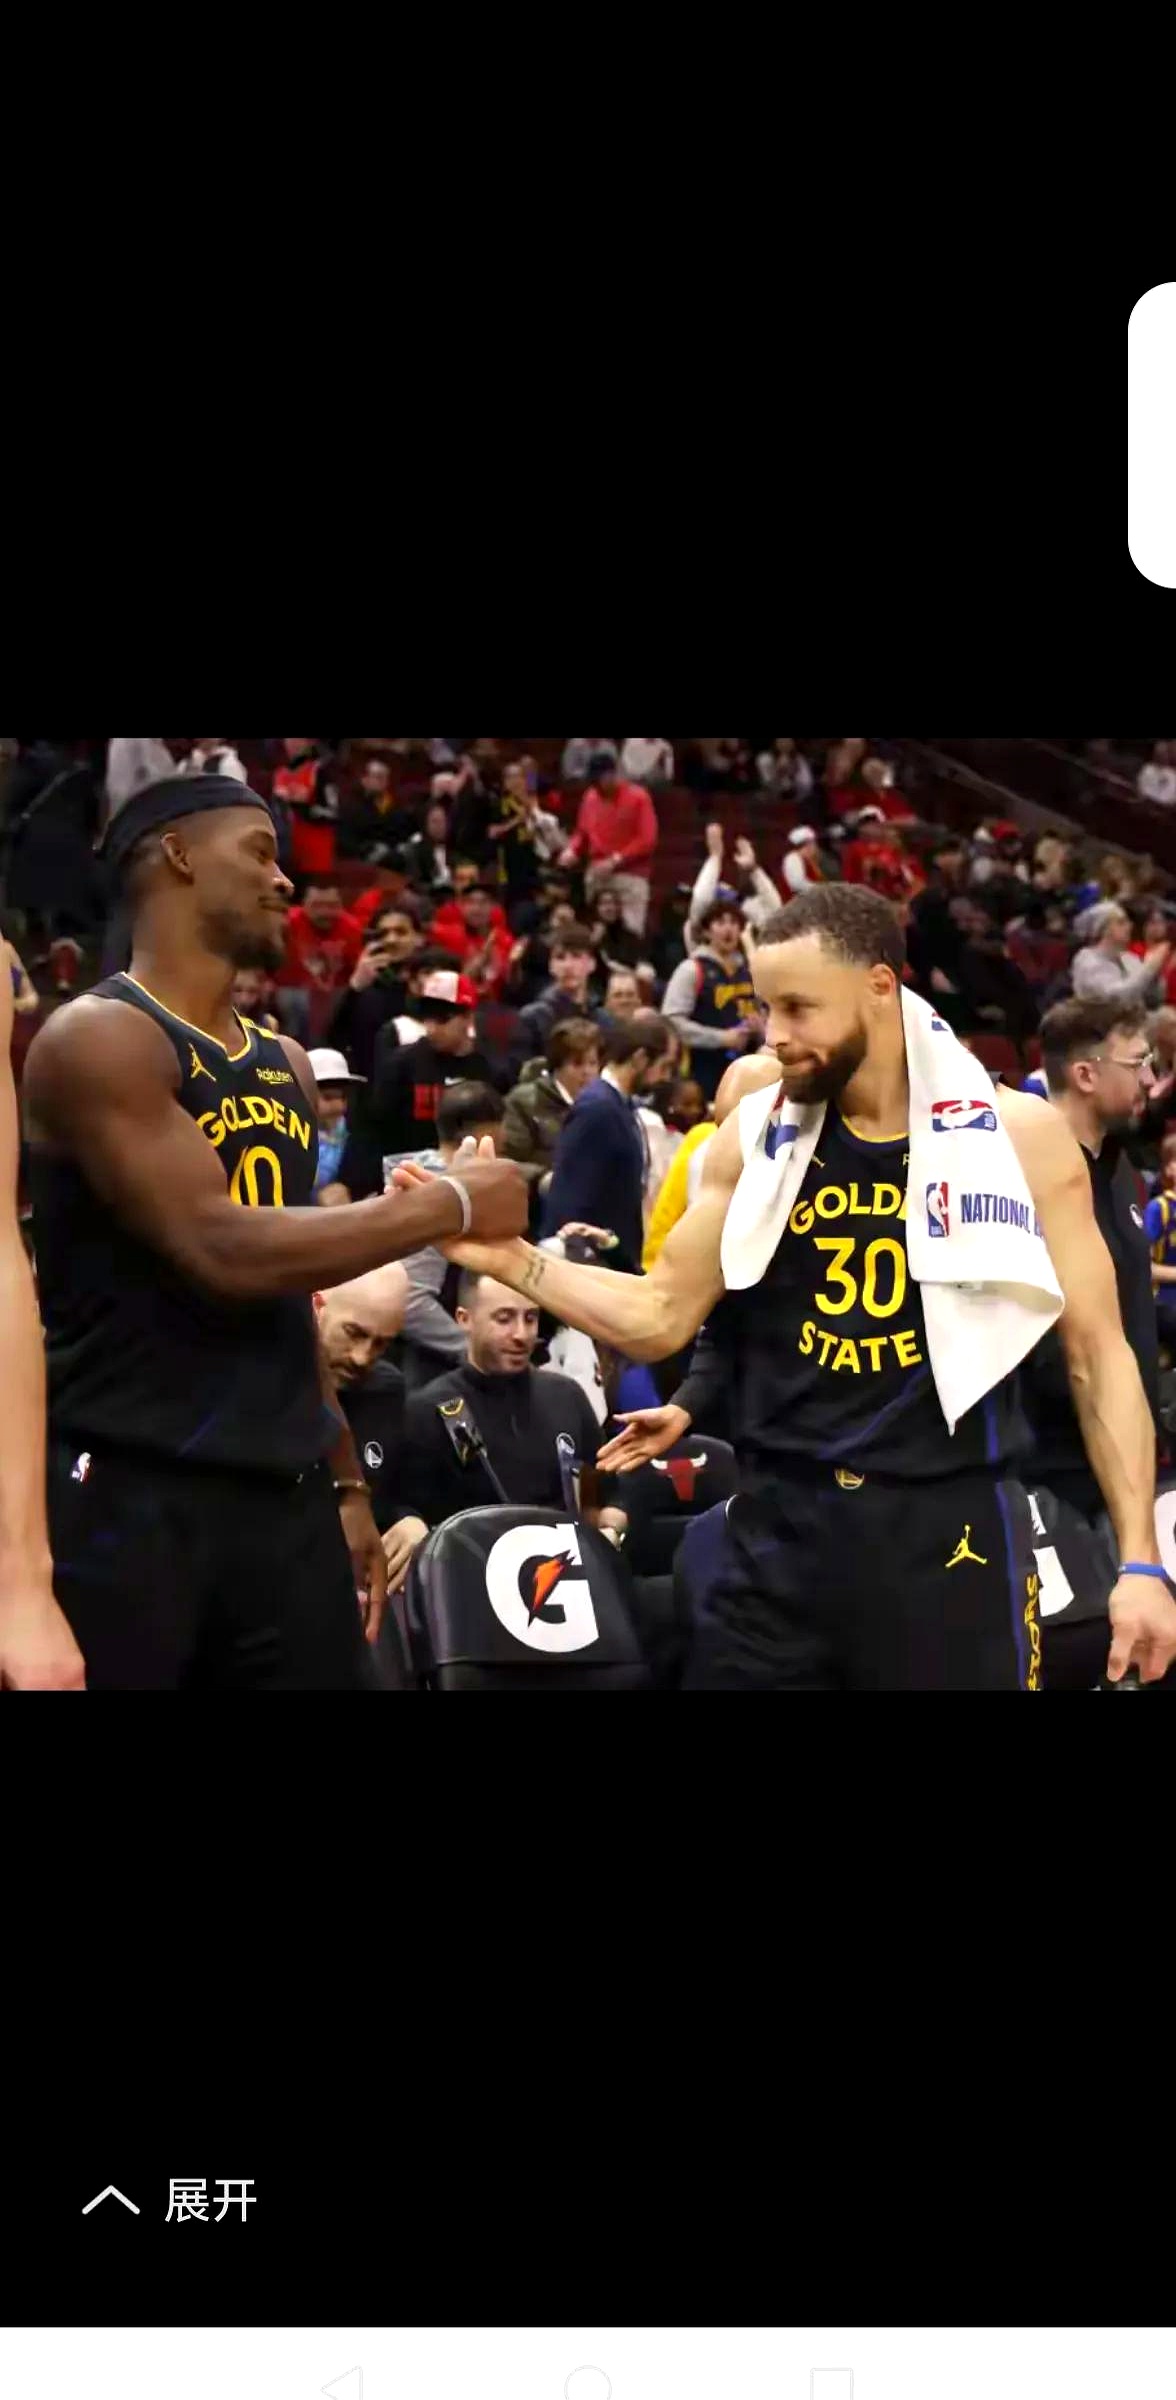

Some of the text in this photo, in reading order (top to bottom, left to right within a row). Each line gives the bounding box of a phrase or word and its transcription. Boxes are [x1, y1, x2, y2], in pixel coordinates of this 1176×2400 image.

[197, 1096, 311, 1151] GOLDEN
[789, 1183, 907, 1235] GOLD
[960, 1193, 1031, 1234] NATIONAL
[814, 1237, 907, 1318] 30
[798, 1320, 922, 1374] STATE
[485, 1521, 600, 1653] G
